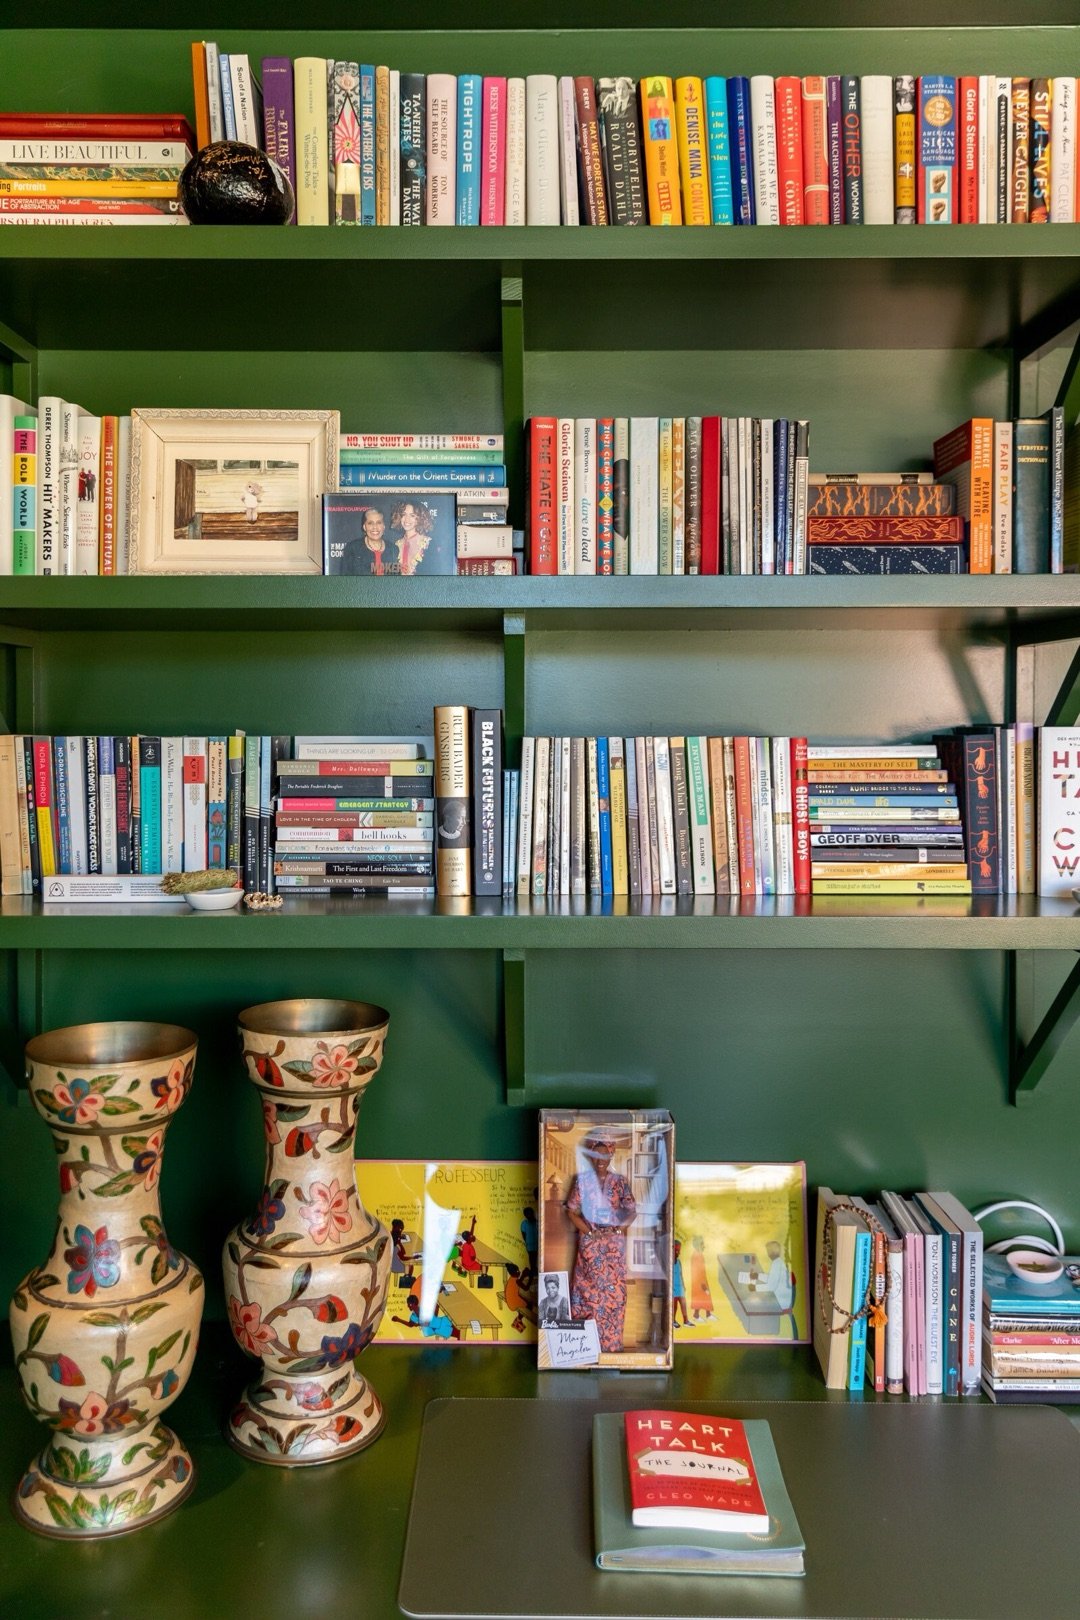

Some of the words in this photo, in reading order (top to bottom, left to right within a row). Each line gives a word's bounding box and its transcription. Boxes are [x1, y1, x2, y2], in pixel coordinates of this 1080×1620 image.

[362, 103, 373, 118] THE
[440, 99, 448, 112] THE
[489, 86, 499, 112] REESE
[582, 87, 590, 109] PERRY
[765, 92, 773, 118] THE
[786, 87, 794, 121] EIGHT
[848, 91, 857, 110] THE
[966, 89, 976, 121] Gloria
[403, 99, 412, 141] COATES
[412, 93, 421, 149] TA-NEHISI
[463, 80, 474, 173] TIGHTROPE
[686, 107, 700, 145] DENISE
[1016, 89, 1027, 140] NEVER
[1034, 92, 1049, 139] STILL
[362, 120, 373, 162] MYSTERIES
[440, 113, 448, 149] SOURCE
[489, 112, 499, 173] WITHERSPOON
[845, 113, 861, 177] OTHER
[922, 138, 955, 148] SIGN
[12, 145, 49, 159] LIVE
[54, 145, 148, 160] BEAUTIFUL
[440, 150, 448, 161] OF
[610, 123, 623, 171] ROALD
[767, 123, 776, 174] TRUTHS
[966, 124, 976, 170] Steinem
[363, 163, 374, 175] OF
[626, 122, 642, 218] STORYTELLER
[689, 149, 702, 179] MINA
[1033, 146, 1048, 199] LIVES
[13, 182, 46, 192] Portraits
[363, 176, 374, 191] ISIS
[440, 175, 448, 195] TONI
[512, 177, 520, 205] ALICE
[769, 180, 777, 199] WE
[1014, 145, 1028, 213] CAUGHT
[431, 175, 439, 219] MORRISON
[614, 181, 627, 220] DAHL
[657, 181, 671, 211] GIRLS
[851, 180, 860, 219] WOMAN
[64, 412, 72, 442] Silverstein
[561, 423, 571, 456] Gloria
[584, 427, 592, 448] Brené
[20, 433, 28, 451] THE
[105, 446, 113, 466] THE
[346, 436, 361, 448] NO,
[362, 436, 379, 447] YOU
[380, 436, 402, 447] SHUT
[403, 436, 414, 447] UP
[690, 431, 698, 460] MARY
[974, 426, 983, 469] O'DONNELL
[20, 457, 28, 483] BOLD
[79, 452, 97, 461] JOY
[1000, 443, 1009, 471] FAIR
[105, 470, 113, 509] POWER
[368, 472, 397, 481] Murder
[409, 473, 421, 481] the
[423, 470, 448, 481] Orient
[450, 470, 477, 482] Express
[562, 458, 571, 502] Steinem
[673, 422, 684, 535] HEAVY
[690, 465, 698, 508] OLIVER
[974, 477, 982, 497] WITH
[43, 484, 53, 502] HIT
[1000, 476, 1009, 506] PLAY
[20, 489, 28, 527] WORLD
[63, 505, 71, 533] Sidewalk
[105, 514, 113, 528] OF
[581, 498, 591, 524] dare
[974, 500, 982, 518] FIRE
[43, 508, 53, 561] MAKERS
[581, 526, 590, 536] to
[662, 536, 669, 547] OF
[688, 516, 698, 556] Upstream
[999, 530, 1007, 559] Rodsky
[104, 533, 113, 572] RITUAL
[581, 538, 591, 562] lead
[453, 715, 463, 746] RUTH
[481, 721, 494, 766] BLACK
[440, 722, 450, 781] GINSBURG
[116, 767, 127, 790] HARLEM
[453, 748, 464, 789] BADER
[672, 752, 684, 781] Loving
[690, 745, 702, 792] INVISIBLE
[696, 794, 706, 816] MAN
[481, 768, 494, 829] FUTURES
[677, 782, 686, 806] What
[759, 770, 769, 806] mindset
[678, 807, 687, 816] Is
[361, 830, 378, 840] bell
[380, 830, 407, 840] hooks
[679, 829, 687, 850] Byron
[818, 834, 861, 845] GEOFF
[865, 834, 901, 844] DYER
[90, 850, 98, 871] CLASS
[680, 851, 688, 869] Katie
[424, 1167, 506, 1184] ROFESSEUR
[931, 1240, 939, 1260] TONI
[931, 1262, 939, 1305] MORRISON
[969, 1312, 976, 1321] OF
[556, 1332, 588, 1347] Maya
[556, 1344, 592, 1359] Angelou
[930, 1350, 938, 1364] EYE
[637, 1419, 733, 1438] HEART
[650, 1435, 726, 1454] TALK
[644, 1458, 672, 1466] THE
[681, 1459, 744, 1476] JOURNAL
[646, 1492, 693, 1500] CLEO
[704, 1493, 752, 1507] WADE
